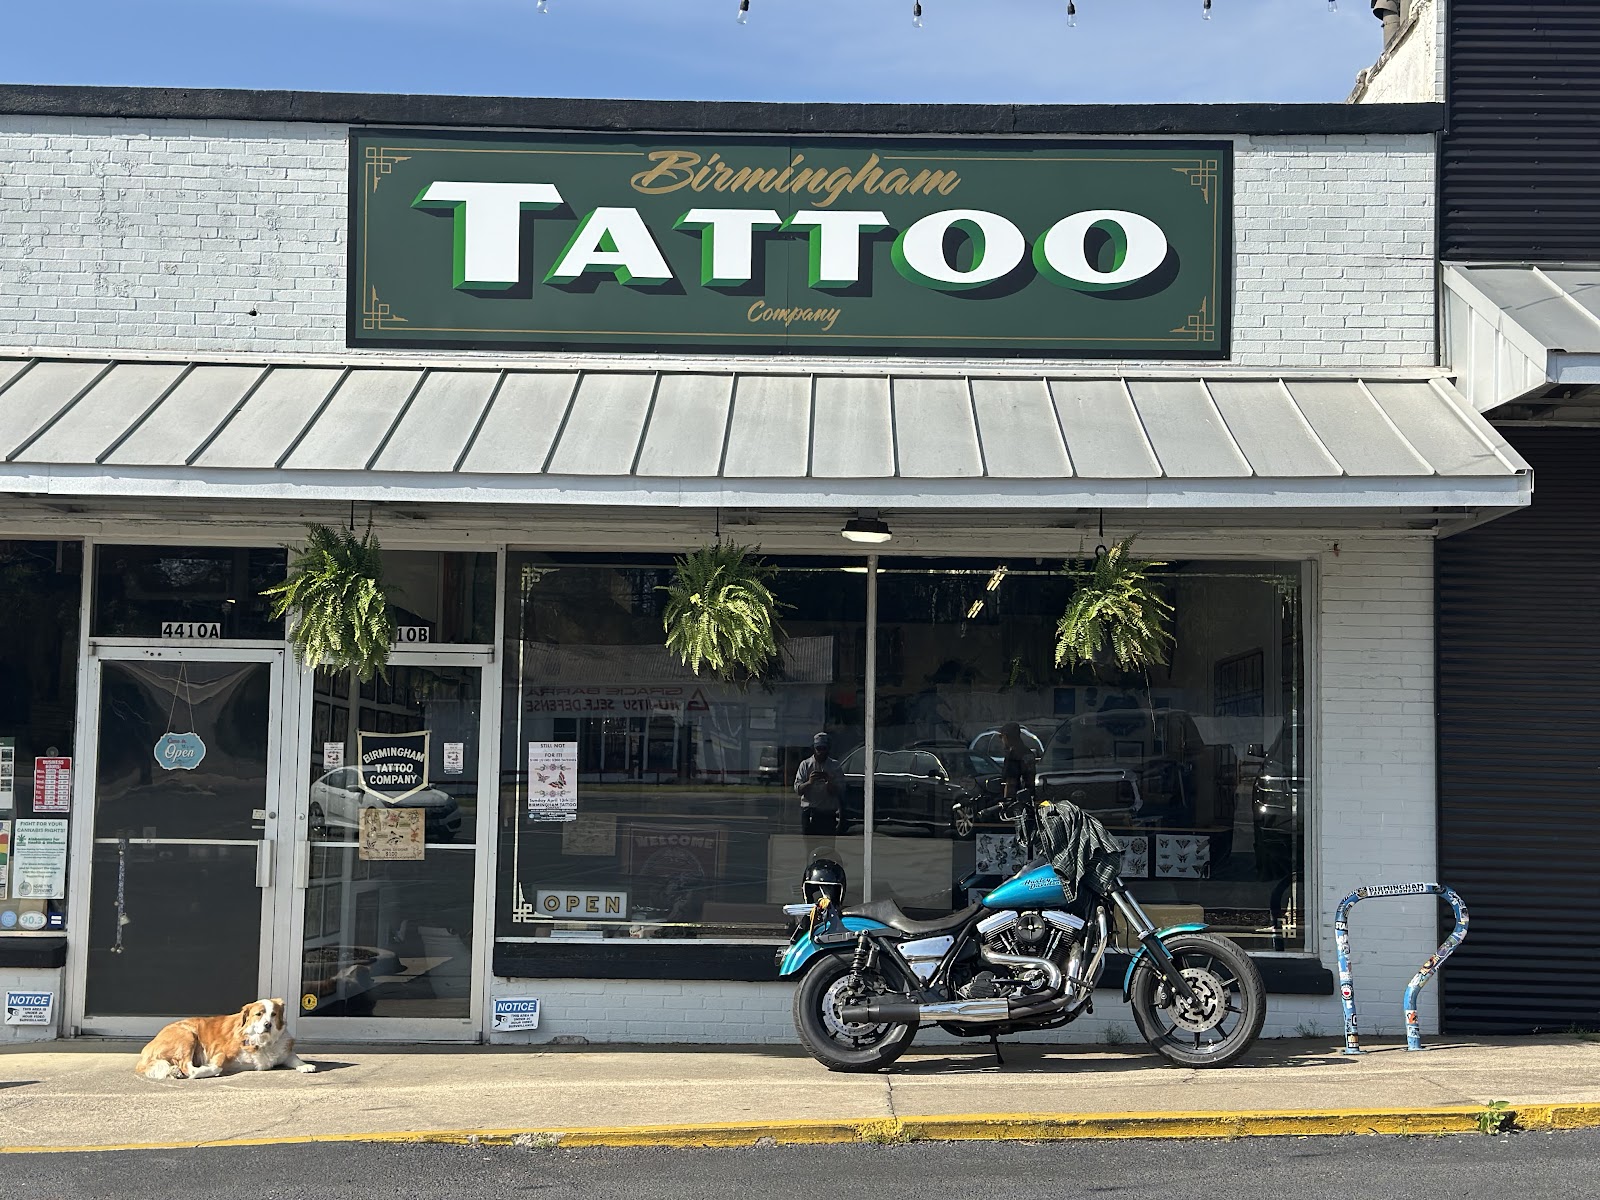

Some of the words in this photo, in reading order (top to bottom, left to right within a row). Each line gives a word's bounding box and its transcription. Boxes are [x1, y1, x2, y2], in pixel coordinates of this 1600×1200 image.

[630, 151, 961, 208] Birmingham
[412, 181, 1172, 293] TATTOO
[747, 300, 841, 331] Company
[163, 623, 219, 639] 4410A
[397, 627, 428, 642] 10B
[165, 743, 195, 763] Open
[362, 747, 425, 764] BIRMINGHAM
[375, 763, 413, 773] TATTOO
[369, 775, 418, 784] COMPANY
[635, 834, 714, 849] WELCOME
[1368, 883, 1424, 892] BIRMINGHAM
[544, 895, 620, 913] OPEN
[22, 915, 44, 924] 90.3
[10, 996, 49, 1005] NOTICE
[497, 1002, 536, 1012] NOTICE
